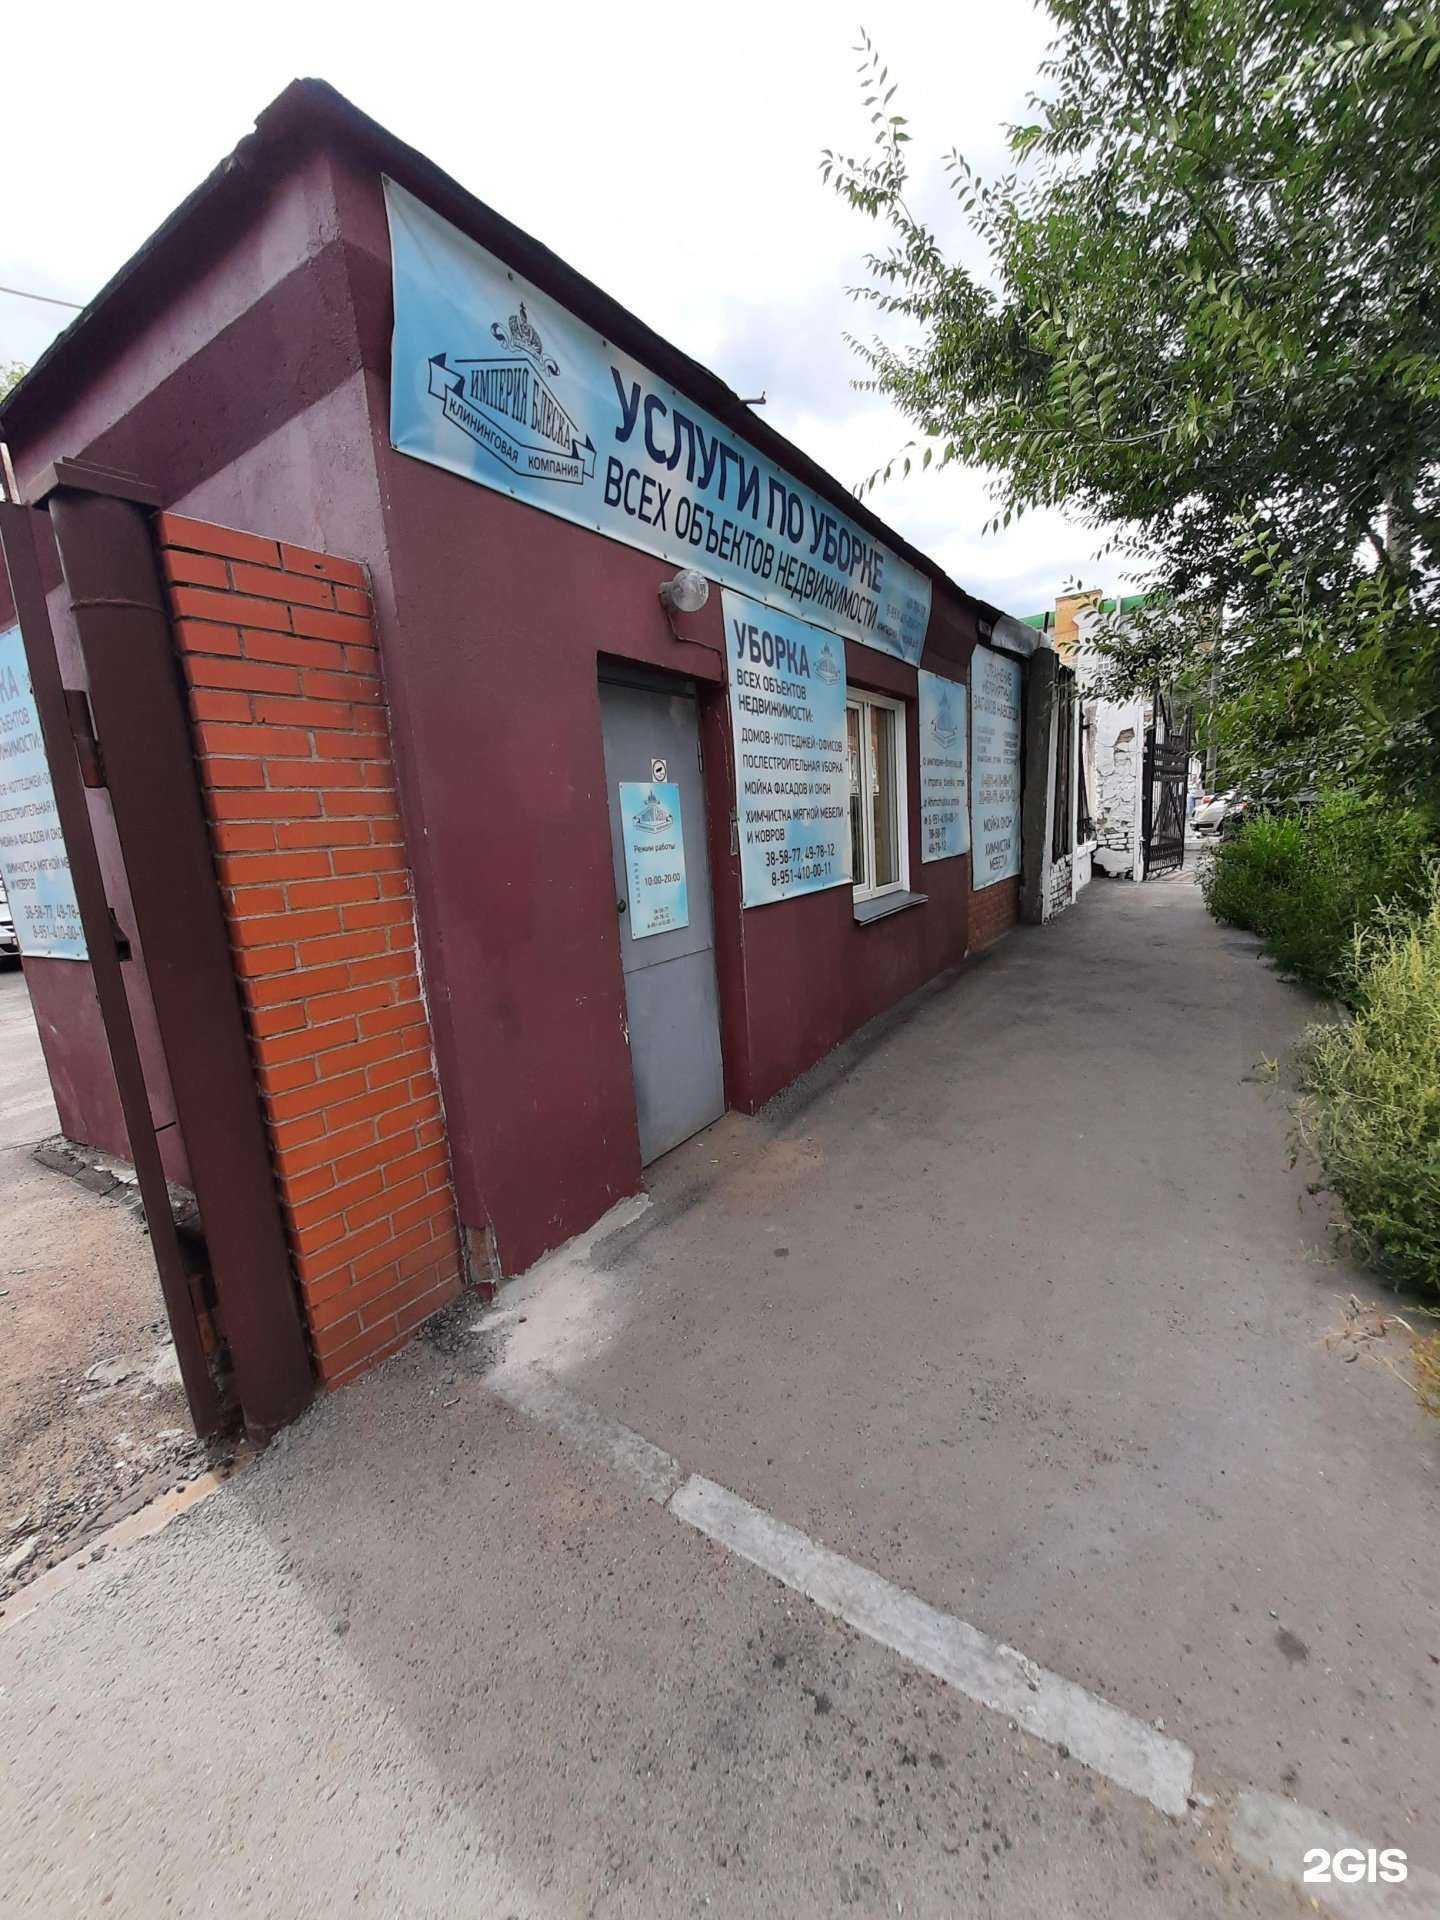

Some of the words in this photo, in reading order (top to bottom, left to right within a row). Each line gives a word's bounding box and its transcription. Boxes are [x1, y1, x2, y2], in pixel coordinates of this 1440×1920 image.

[470, 367, 529, 425] ИМПЕРИЯ
[531, 379, 571, 450] БЛЕСКА
[449, 397, 519, 463] КЛИНИНГОВАЯ
[528, 456, 579, 478] КОМПАНИЯ
[610, 365, 760, 520] УСЛУГИ
[767, 476, 805, 544] ПО
[810, 505, 885, 594] УБОРКЕ
[604, 455, 671, 532] ВСЕХ
[675, 496, 775, 580] ОБЪЕКТОВ
[775, 550, 879, 630] НЕДВИЖИМОСТИ
[733, 618, 811, 679] УБОРКА
[737, 668, 761, 690] ВСЕХ
[763, 676, 807, 700] ОБЪЕКТОВ
[742, 754, 820, 772] ПОСЛЕСТРОИТЕЛЬНАЯ
[821, 760, 843, 773] УБОРКА
[744, 779, 773, 794] МОЙКА
[775, 782, 808, 796] ФАСАДОВ
[809, 784, 815, 795] И
[815, 784, 831, 795] ОКОН
[745, 808, 792, 823] ХИМЧИСТКА
[747, 830, 754, 844] И
[755, 828, 785, 842] КОВРОВ
